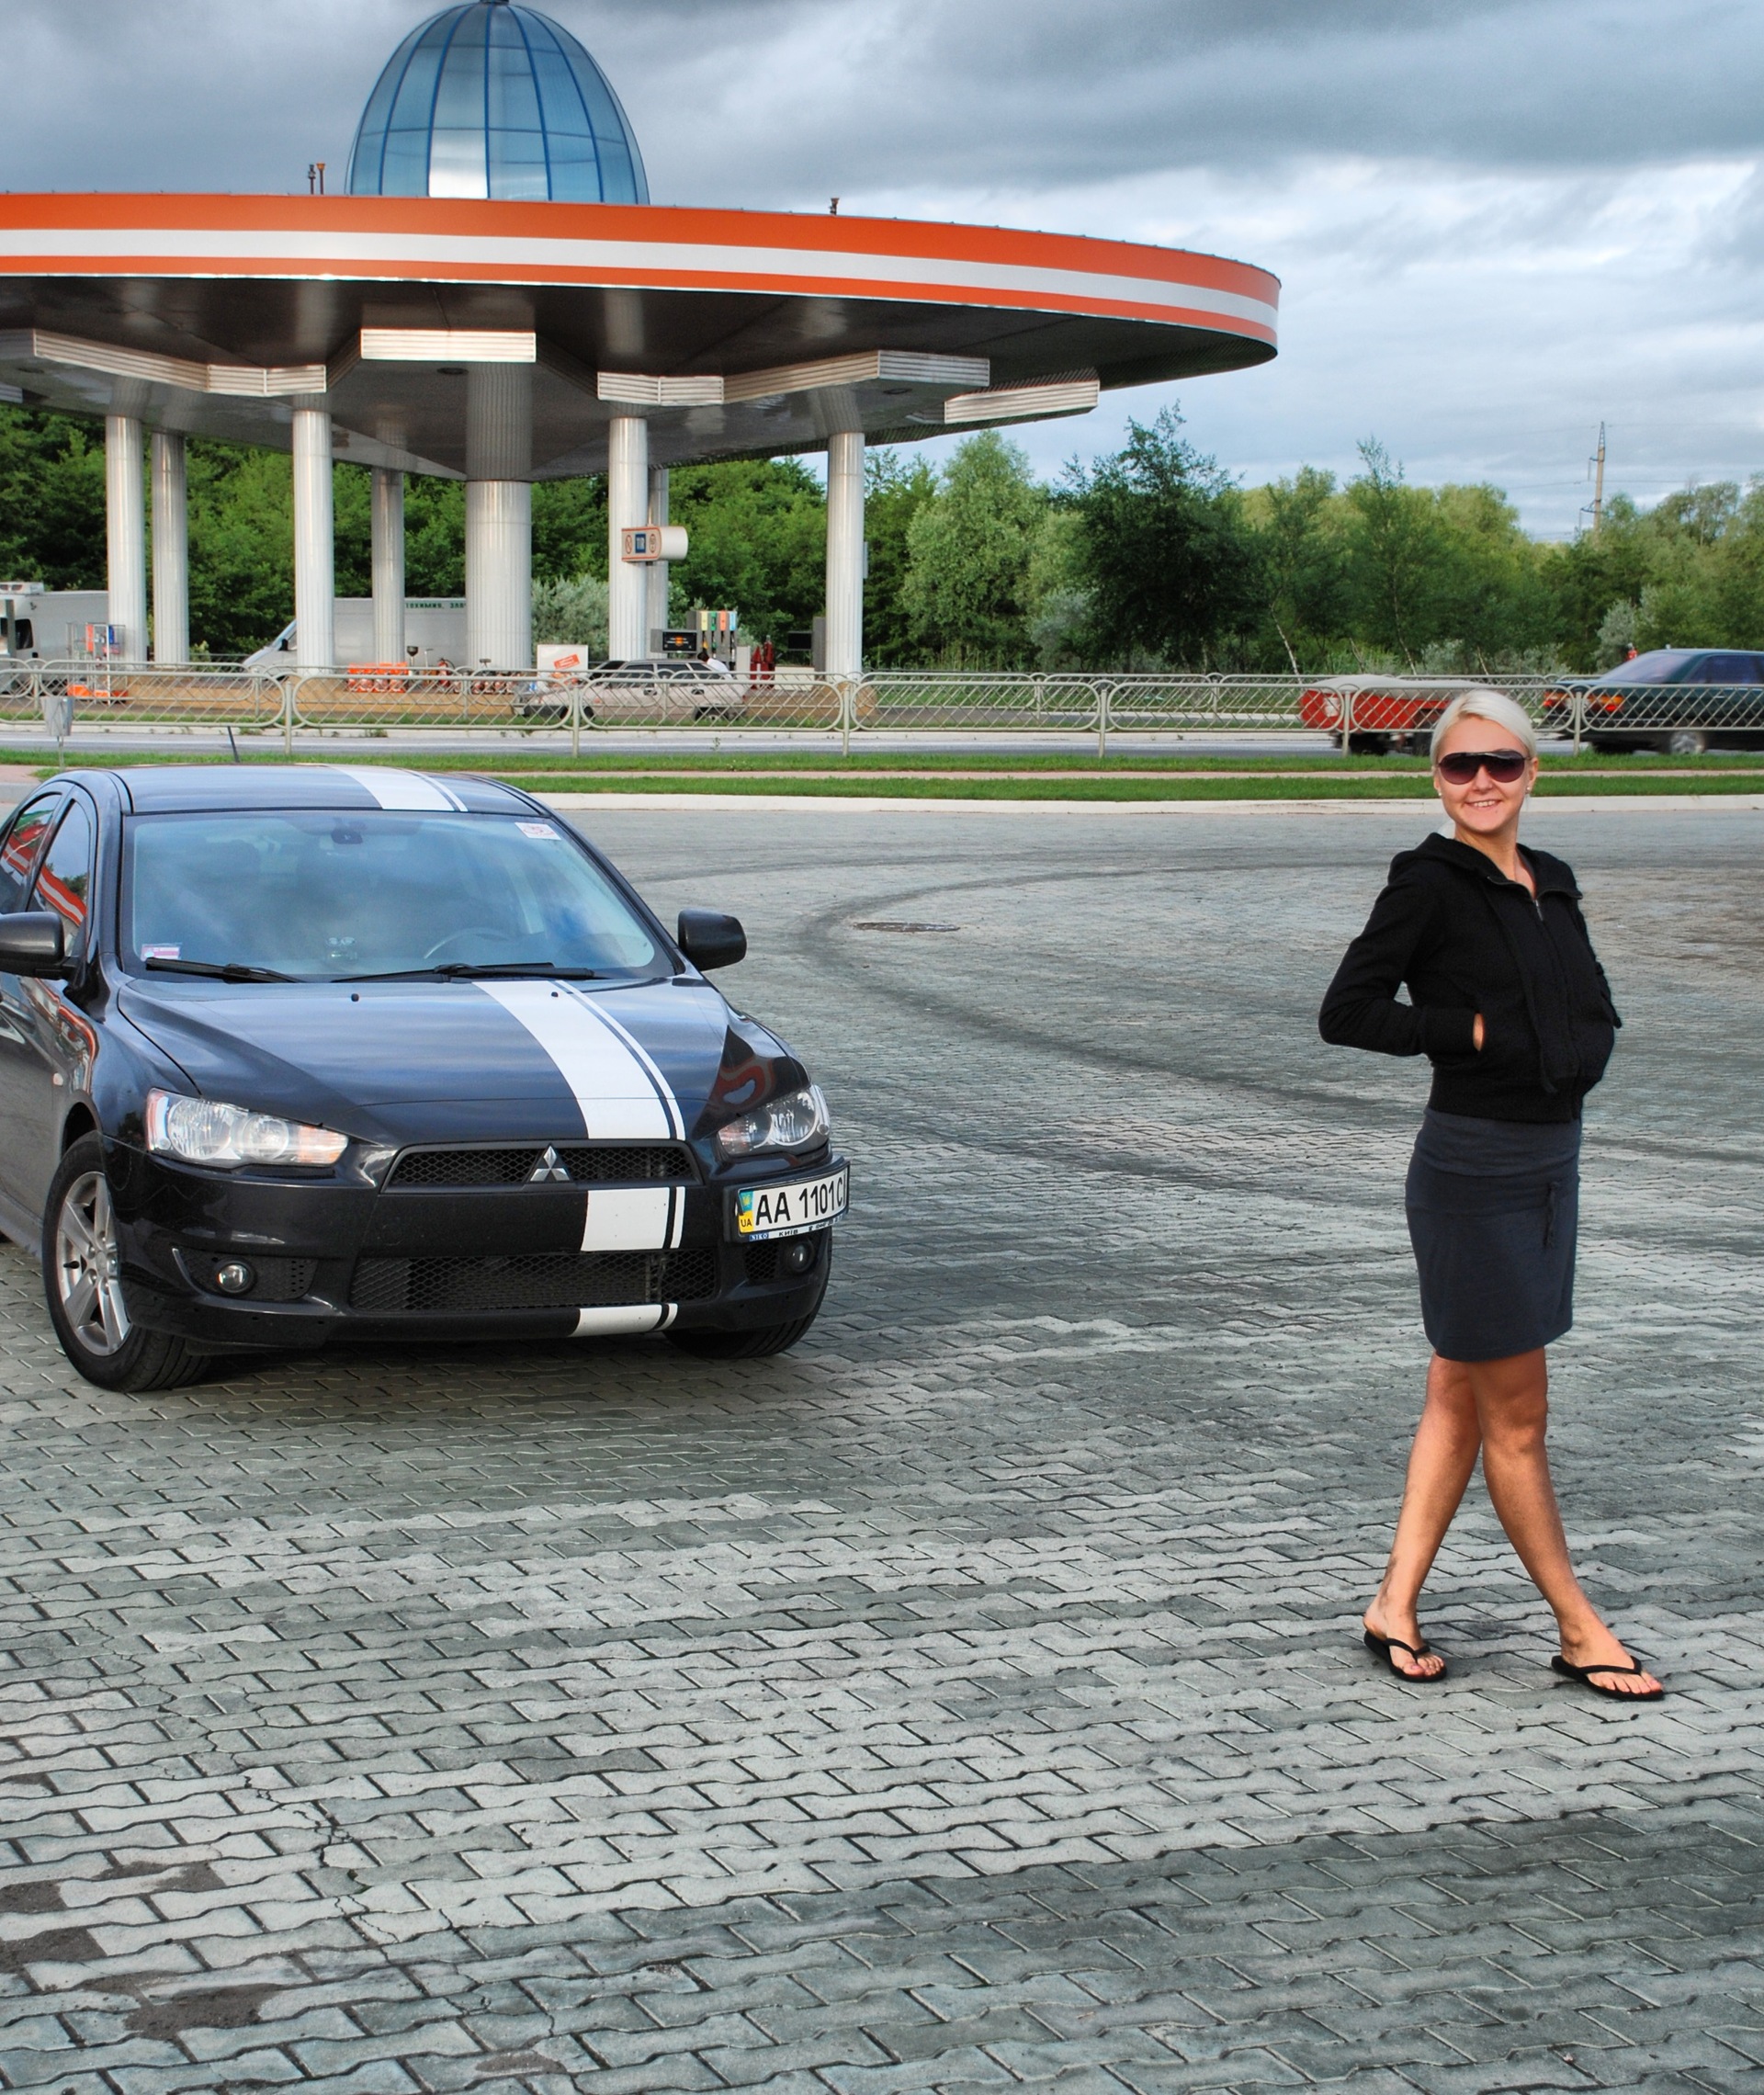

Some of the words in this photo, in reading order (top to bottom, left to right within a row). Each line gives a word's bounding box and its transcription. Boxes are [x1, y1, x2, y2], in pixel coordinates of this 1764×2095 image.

[755, 1192, 791, 1226] AA
[741, 1218, 752, 1228] UA
[751, 1233, 769, 1241] NIKO
